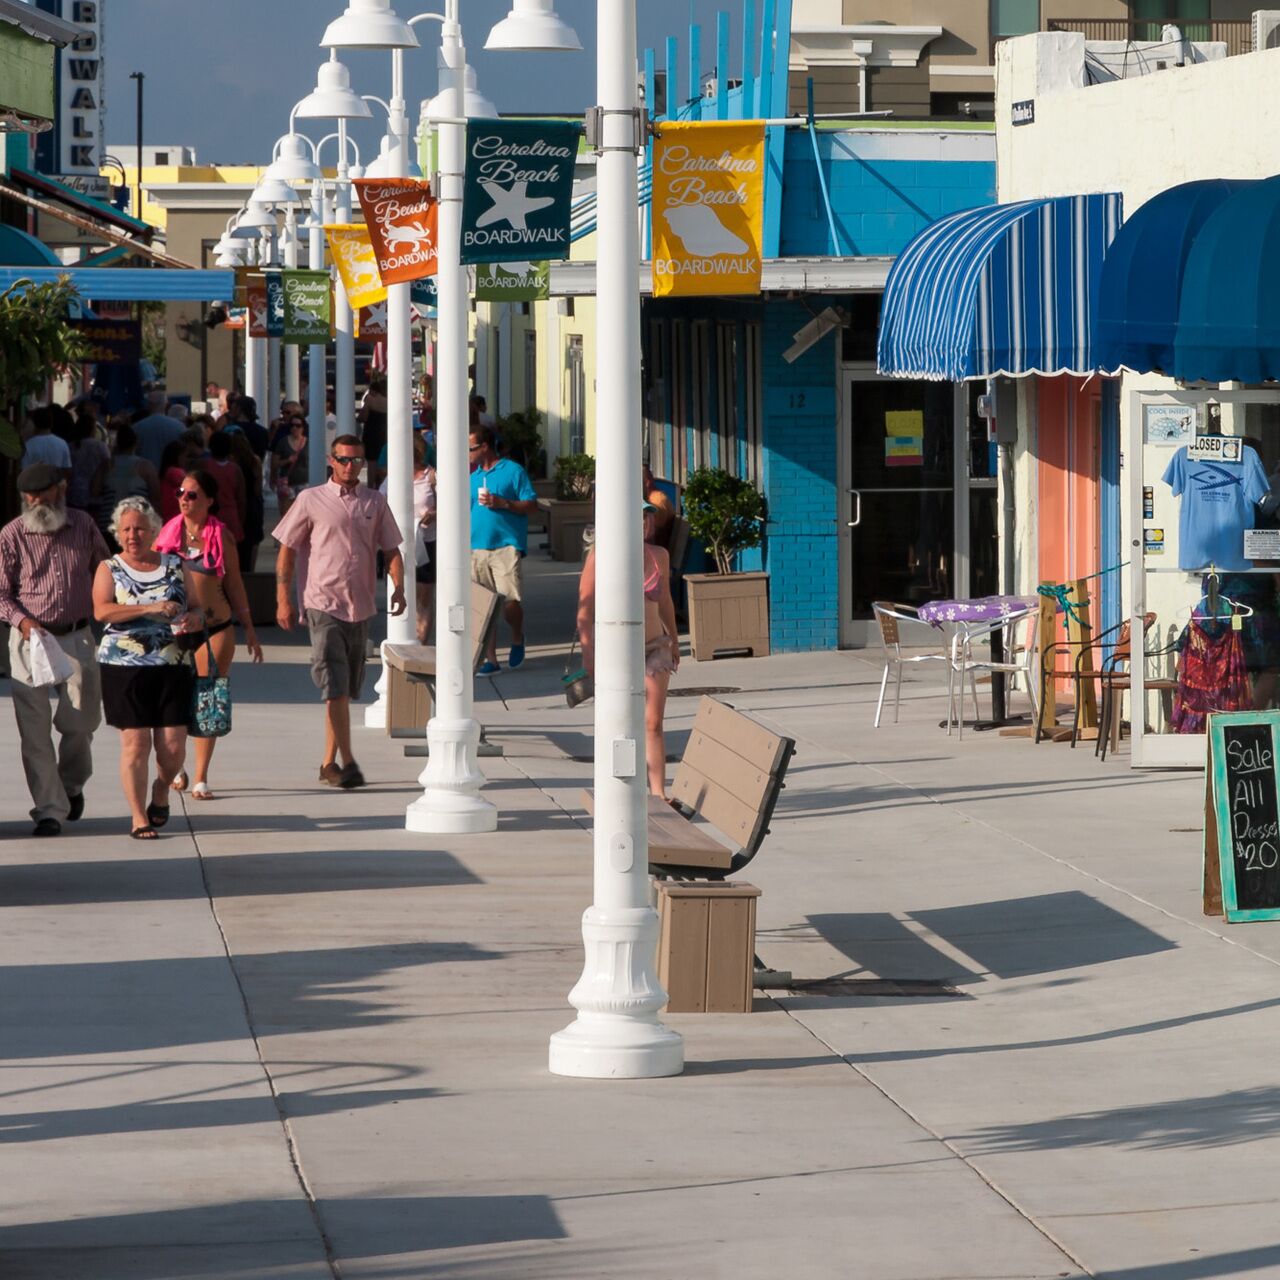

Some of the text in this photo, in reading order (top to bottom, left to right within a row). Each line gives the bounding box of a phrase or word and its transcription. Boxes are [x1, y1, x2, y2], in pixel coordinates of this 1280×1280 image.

[472, 136, 571, 158] Carolina
[477, 159, 560, 184] Beach
[659, 145, 758, 175] Carolina
[666, 177, 748, 205] Beach
[374, 199, 430, 224] Beach
[464, 228, 566, 246] BOARDWALK
[380, 247, 438, 271] BOARDWA
[655, 258, 756, 275] BOARDWALK
[285, 279, 327, 293] Carolina
[478, 275, 548, 288] BOARDWALK
[290, 292, 324, 306] Beach
[788, 393, 806, 409] 12
[1227, 739, 1272, 770] Sale
[1234, 779, 1264, 811] All
[1233, 811, 1278, 839] Dresses
[1236, 841, 1278, 870] $20
